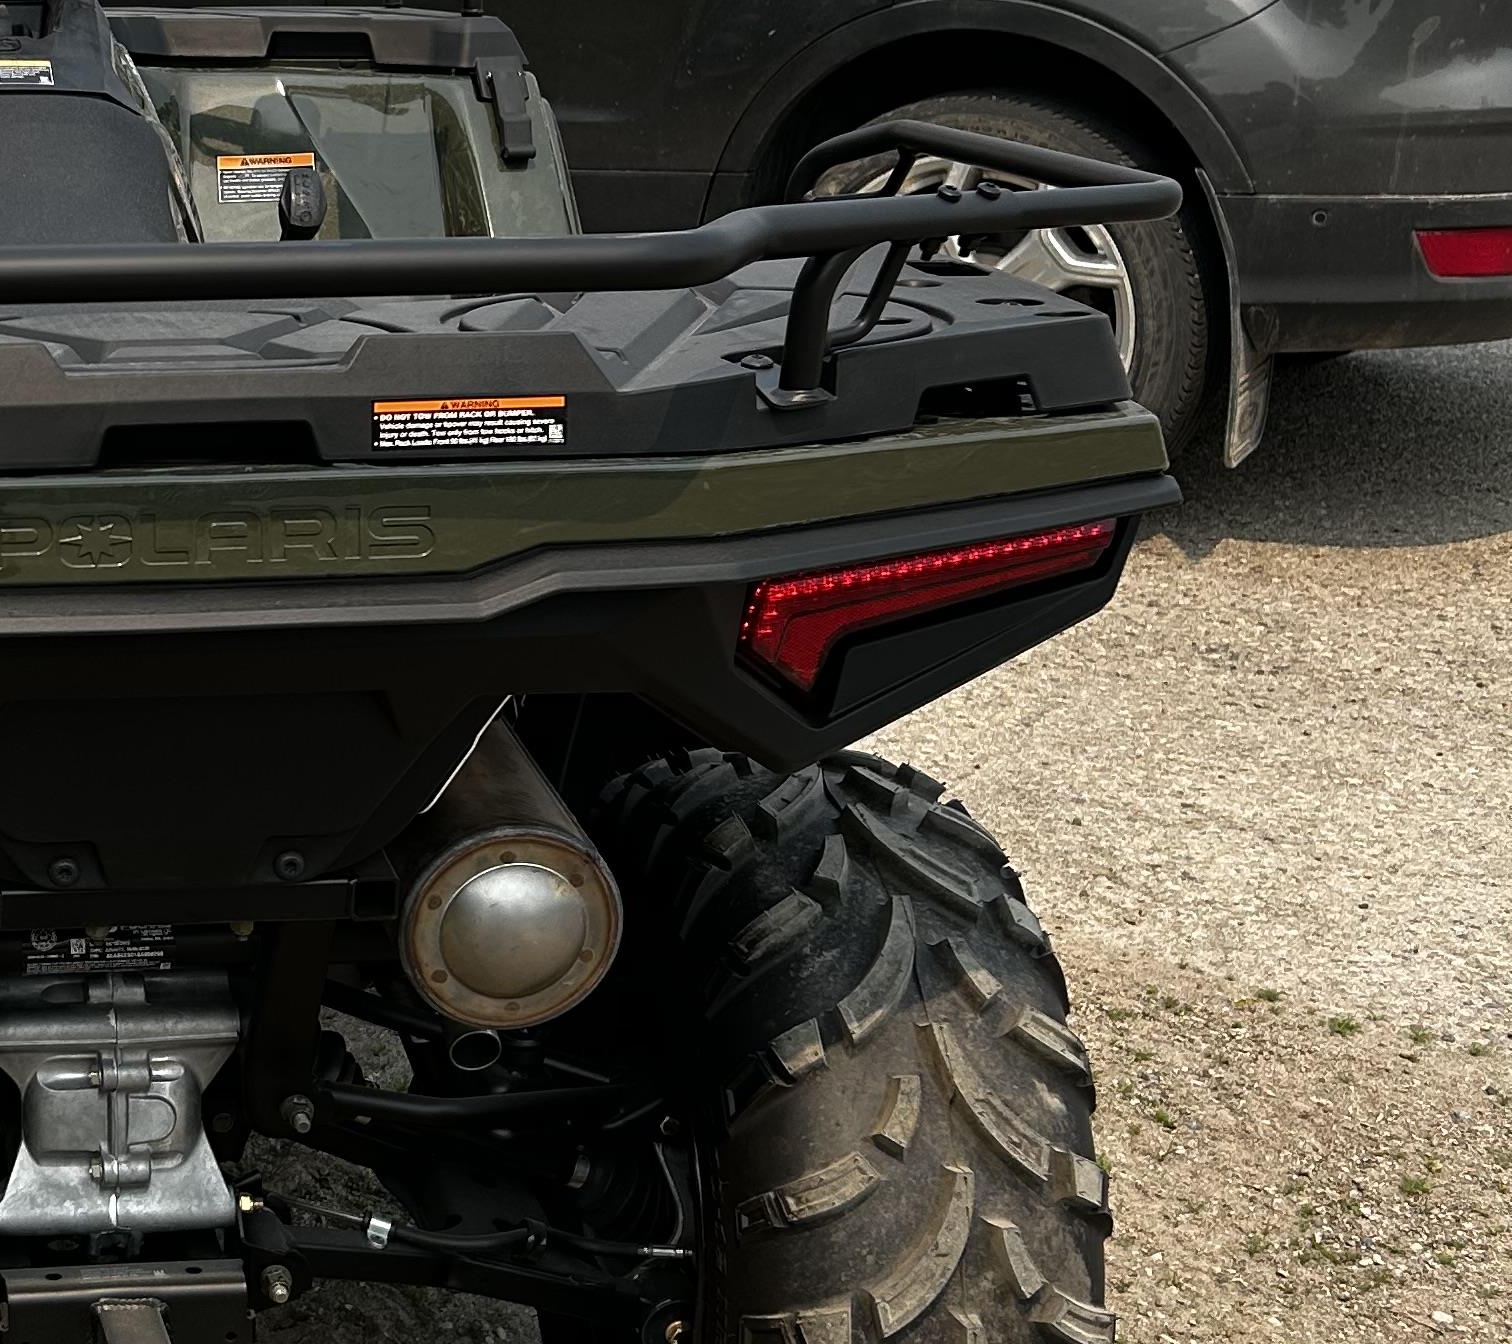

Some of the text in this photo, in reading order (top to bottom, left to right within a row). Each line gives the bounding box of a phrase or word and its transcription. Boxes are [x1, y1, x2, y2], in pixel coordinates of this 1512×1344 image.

[249, 156, 292, 165] WARNING
[450, 400, 500, 409] WARNING
[379, 413, 393, 422] DO
[394, 413, 411, 421] NOT
[433, 411, 458, 419] FROM
[379, 422, 405, 430] Vehicle
[405, 422, 433, 430] damage
[447, 429, 462, 437] only
